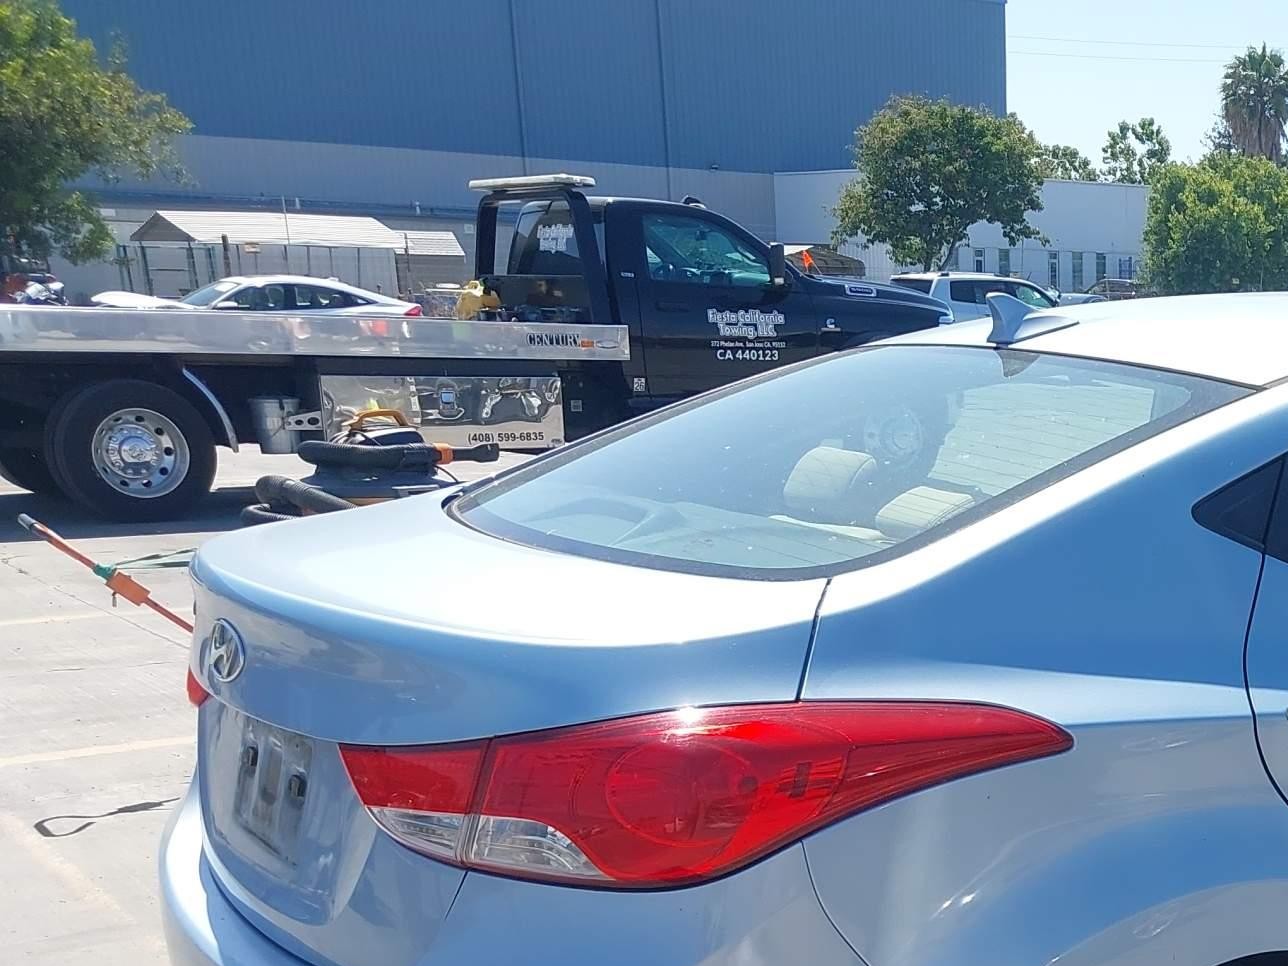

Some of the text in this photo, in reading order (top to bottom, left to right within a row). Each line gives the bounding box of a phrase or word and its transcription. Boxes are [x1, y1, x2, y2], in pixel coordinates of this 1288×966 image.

[707, 309, 785, 324] Fiesta California
[526, 333, 580, 347] CENTURY
[717, 349, 779, 361] CA 440123
[634, 382, 645, 391] 26
[468, 433, 495, 445] (408)
[497, 432, 544, 442] 599-6835
